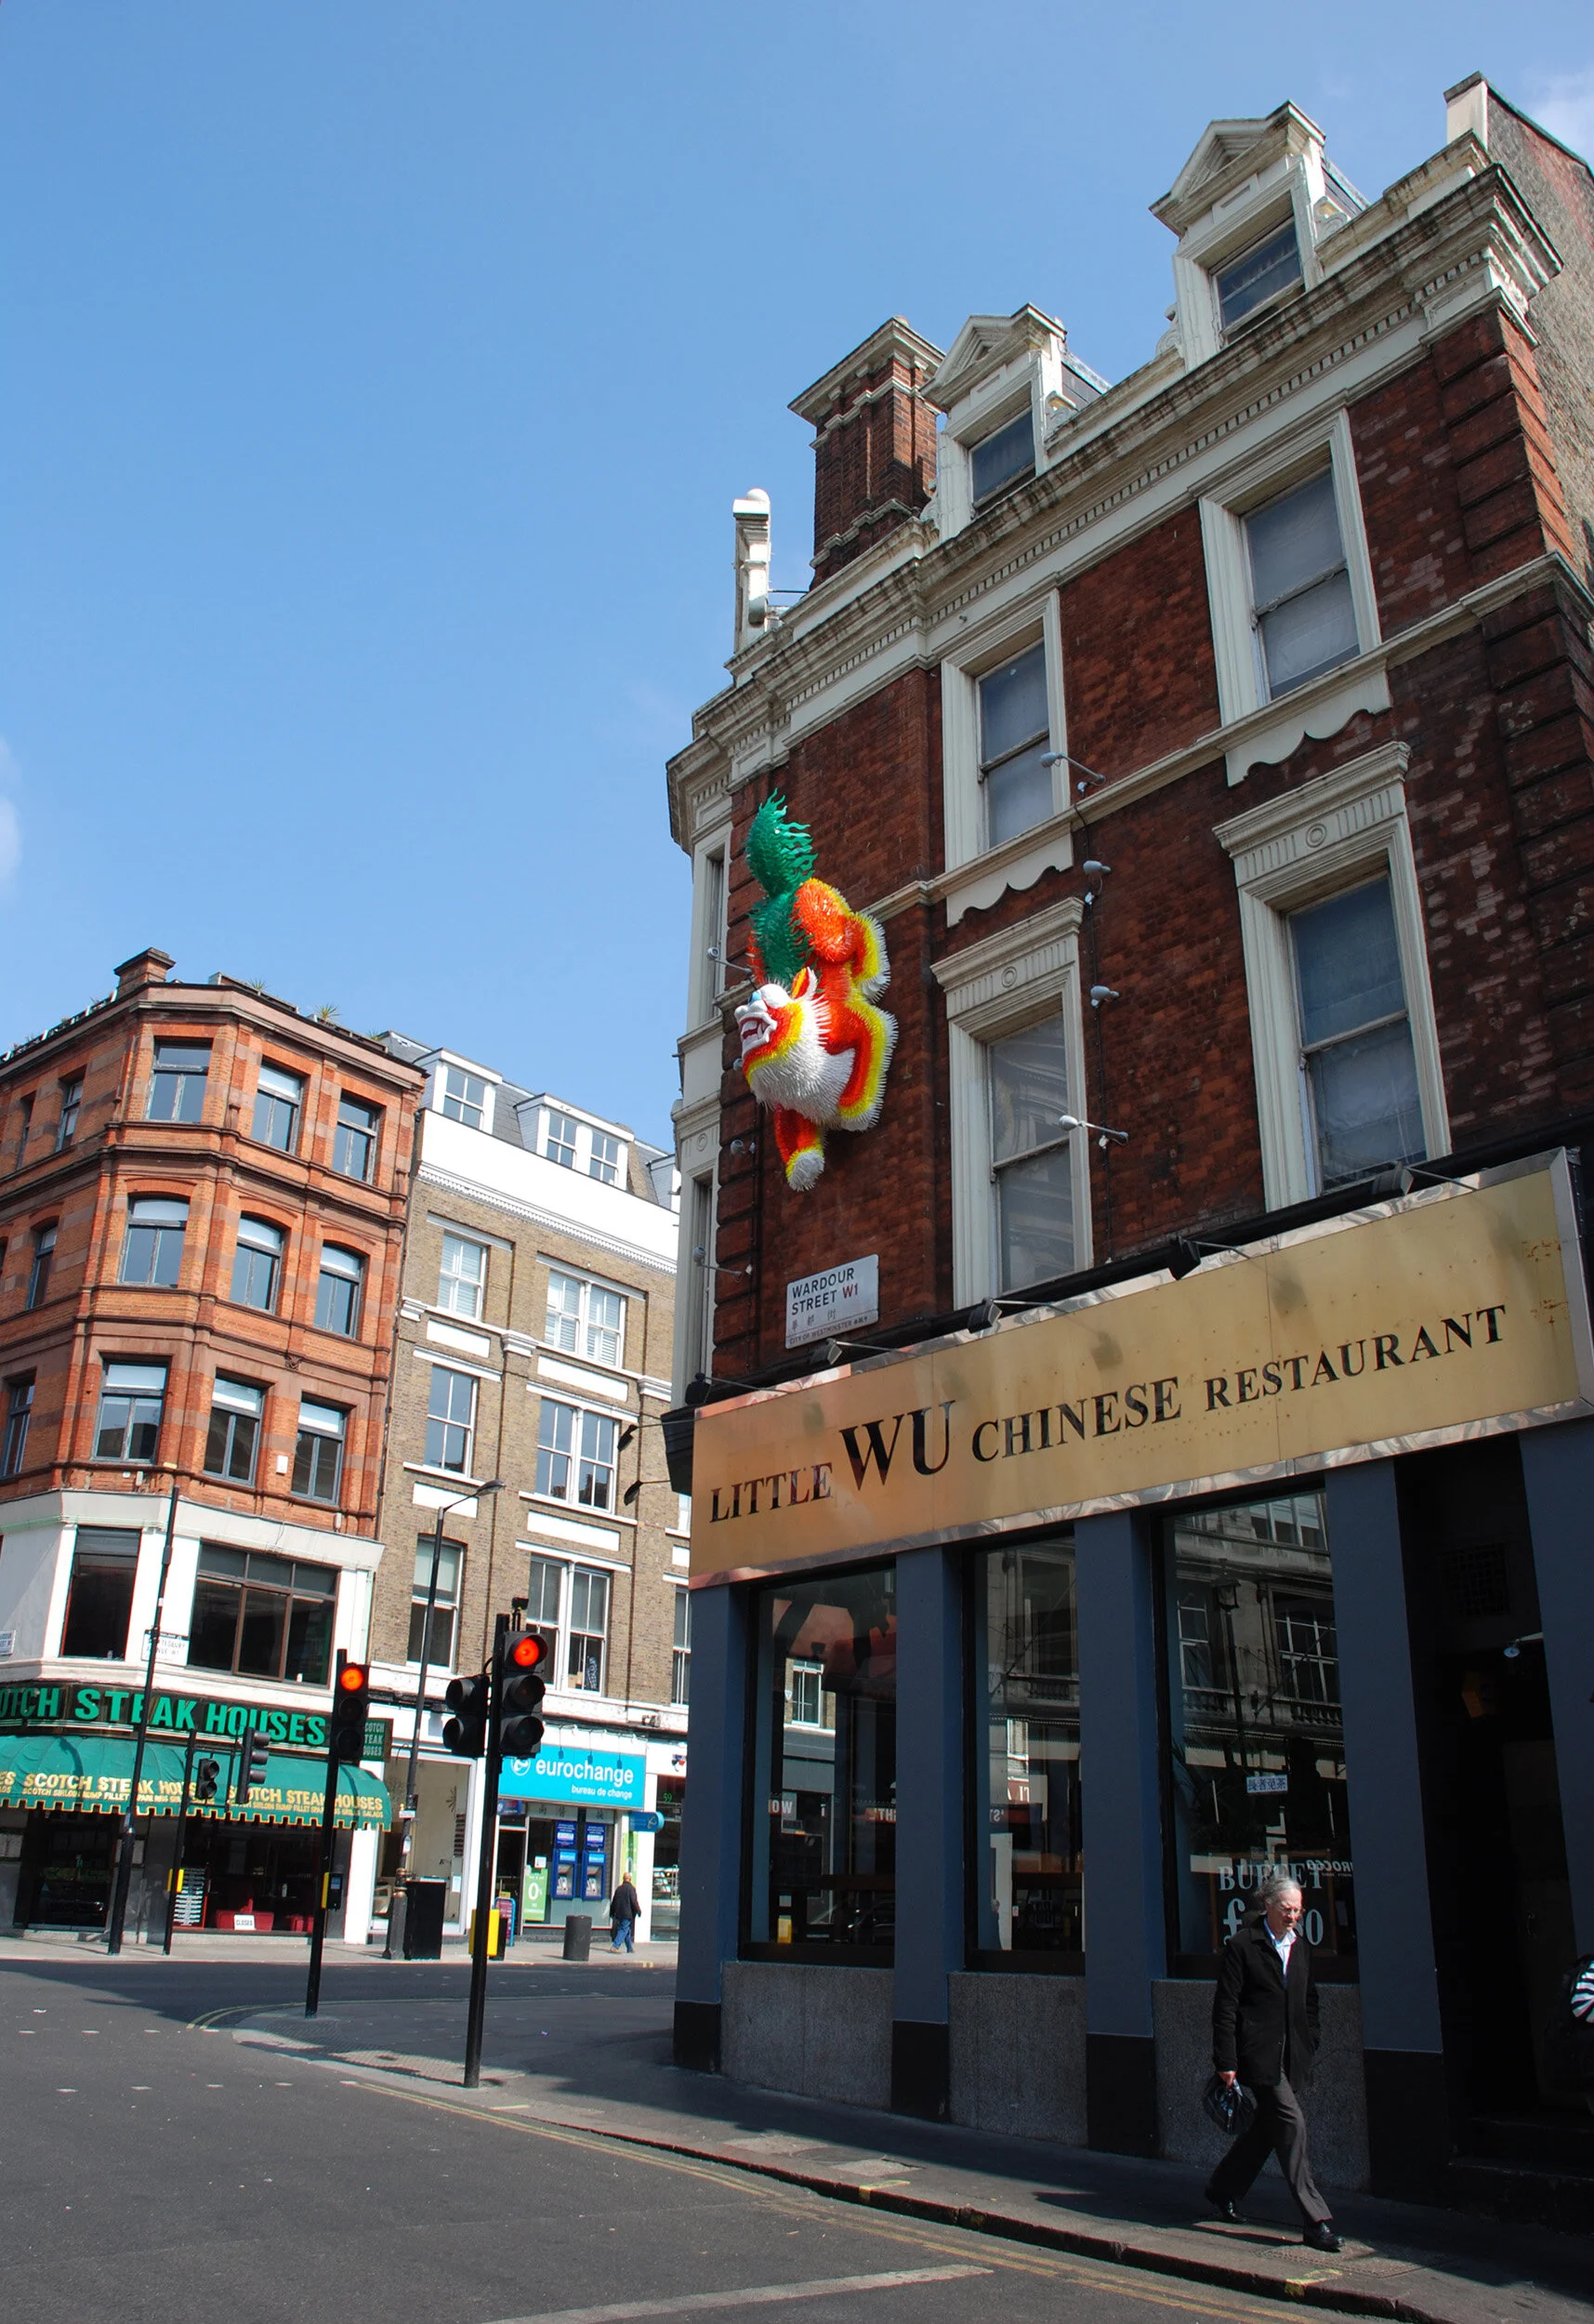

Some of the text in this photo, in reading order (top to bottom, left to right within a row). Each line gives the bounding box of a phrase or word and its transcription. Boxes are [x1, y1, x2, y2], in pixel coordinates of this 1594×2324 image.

[792, 1267, 854, 1299] WARDOUR
[791, 1283, 858, 1315] STREET W1
[789, 1334, 802, 1345] CITY
[811, 1320, 852, 1337] WESTMINSTER
[709, 1304, 1507, 1523] LITTLE WU CHINESE RESTAURANT
[74, 1688, 197, 1730] STEAK
[204, 1703, 325, 1746] HOUSES
[363, 1734, 384, 1745] TEAK
[23, 1773, 93, 1790] SCOTCH
[535, 1759, 634, 1788] eurochange
[22, 1787, 52, 1796] SCOTCH
[82, 1791, 102, 1801] RUMP
[102, 1792, 130, 1802] FILLET
[229, 1785, 283, 1803] SOTCH
[335, 1794, 383, 1811] HOUSES
[571, 1784, 633, 1801] bureau de change
[663, 1793, 673, 1802] 59
